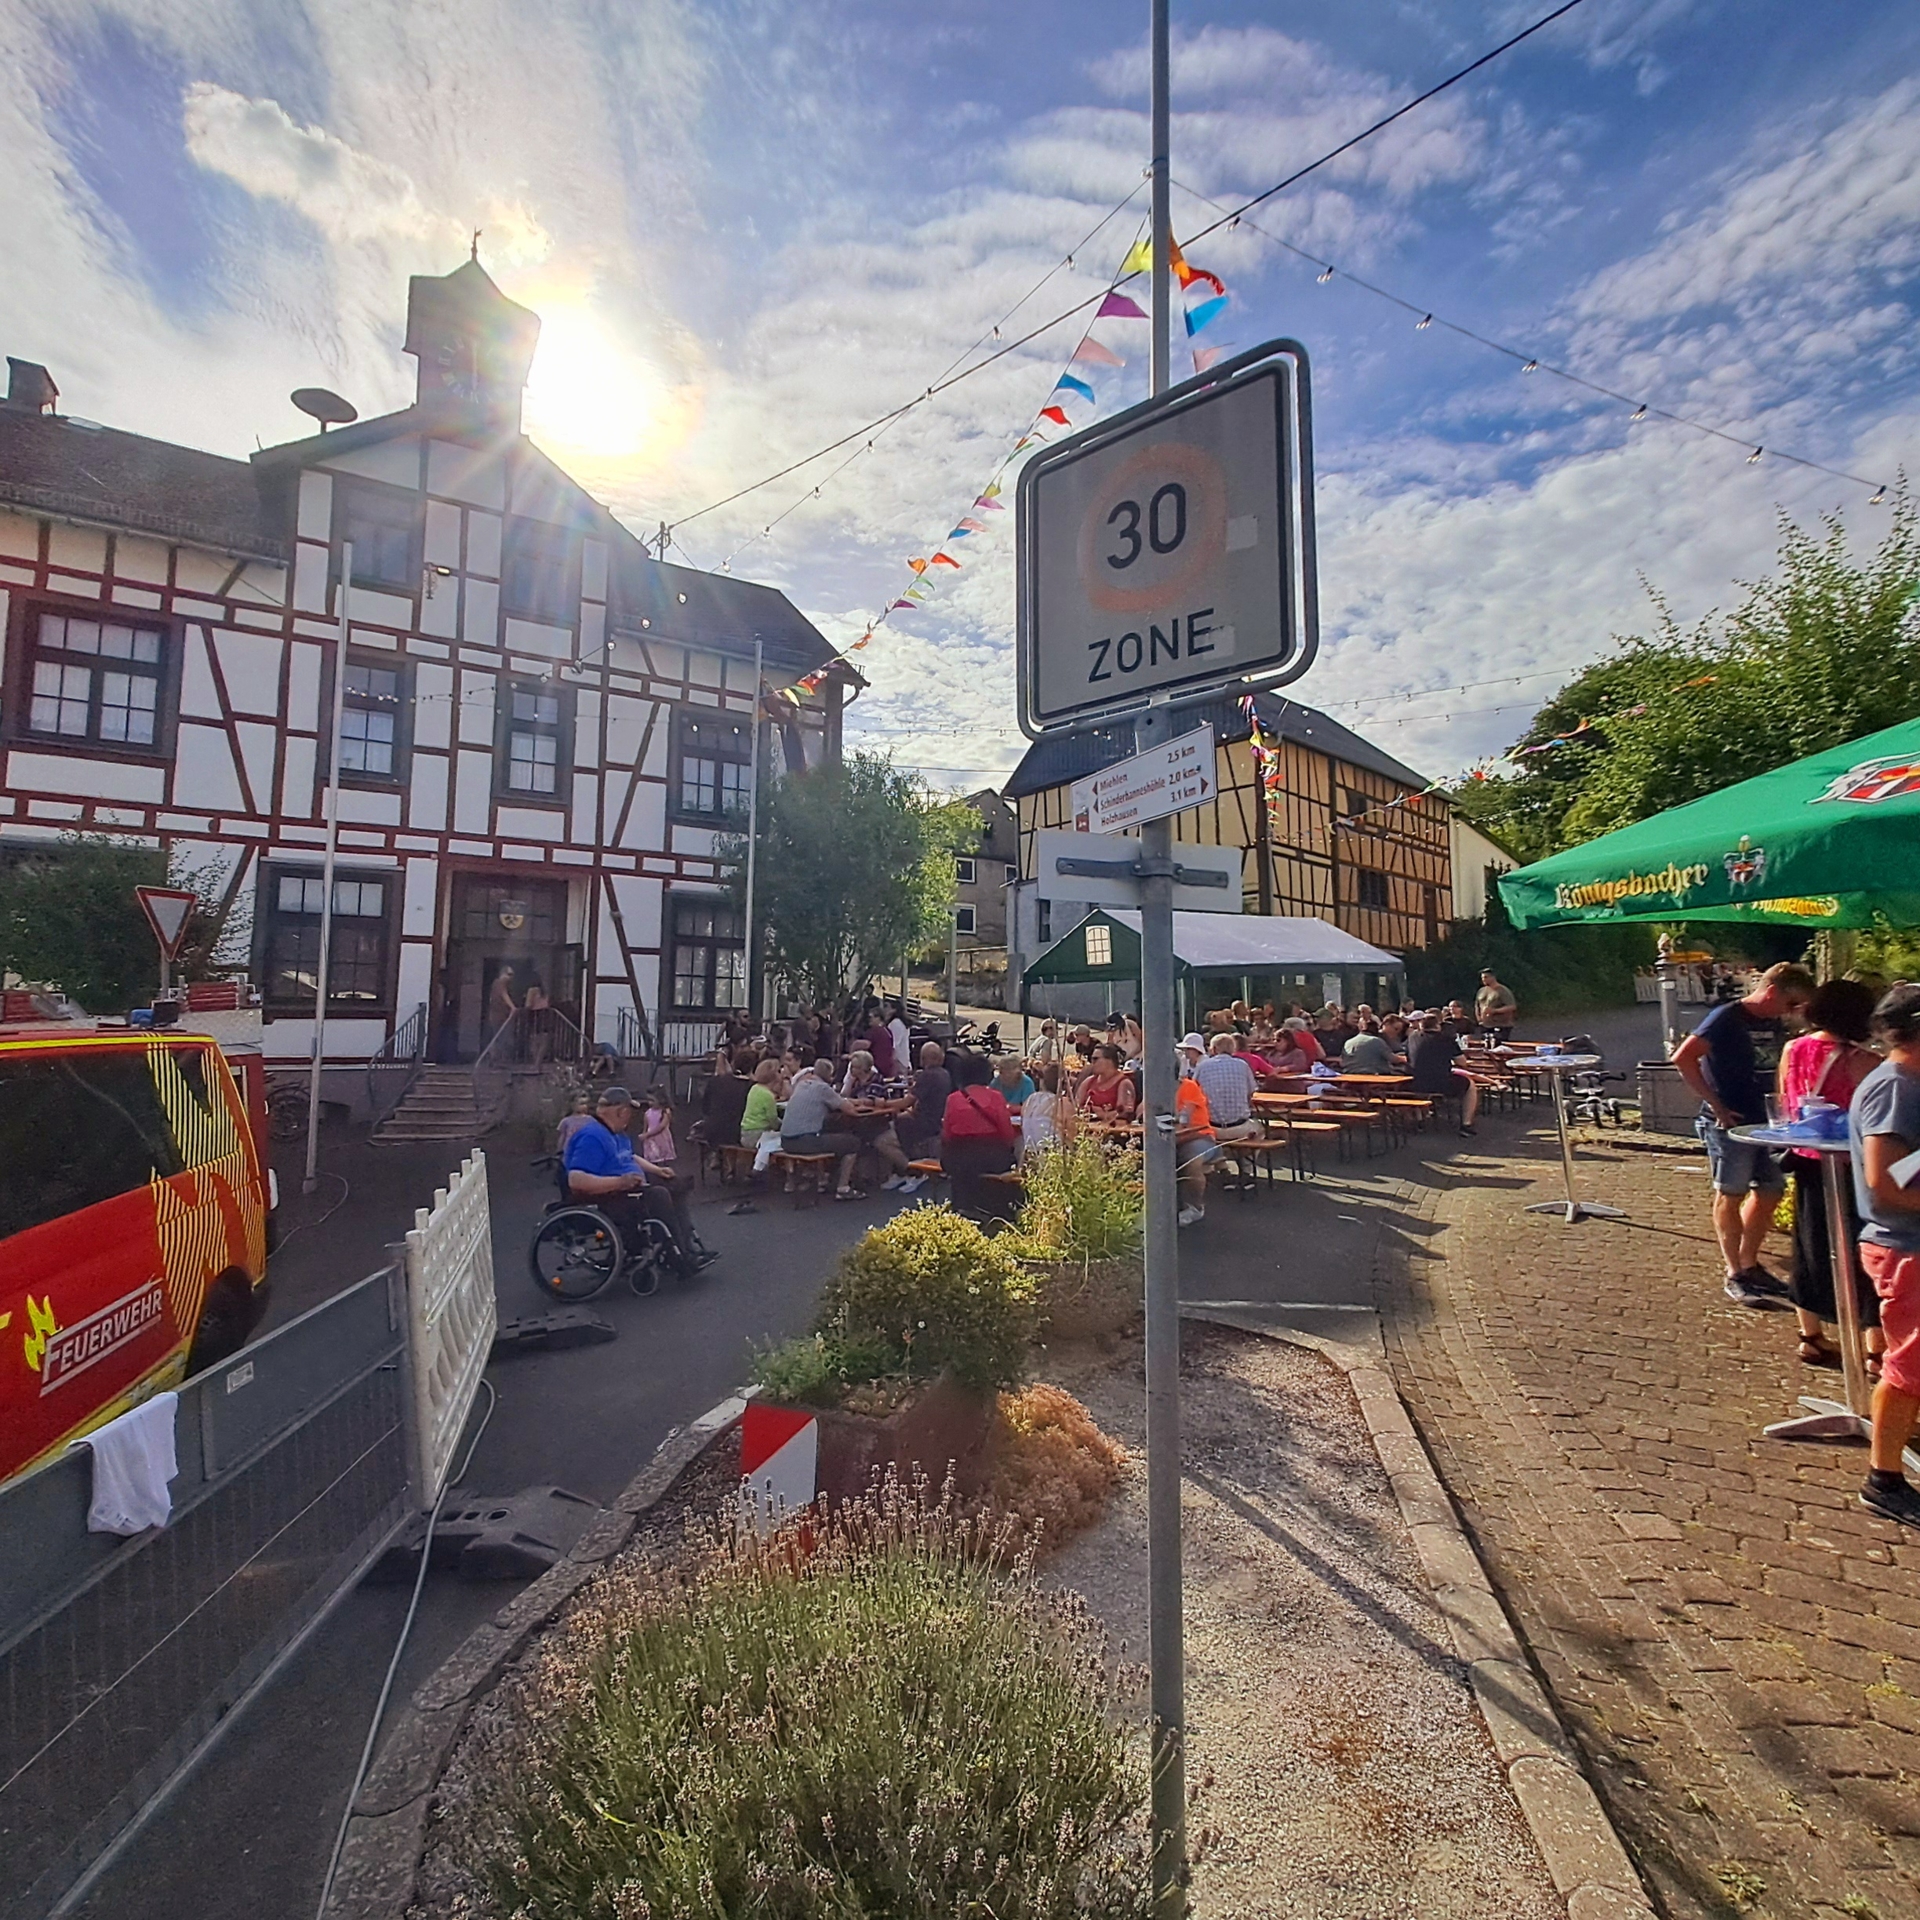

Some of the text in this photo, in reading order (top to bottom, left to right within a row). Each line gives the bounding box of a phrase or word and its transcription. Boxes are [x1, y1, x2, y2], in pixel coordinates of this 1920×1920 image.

[1107, 483, 1186, 569] 30
[1088, 608, 1215, 683] ZONE
[1100, 773, 1128, 791] Miehlen
[1181, 746, 1196, 758] km
[1183, 767, 1197, 779] km
[1101, 807, 1138, 827] Holzhausen
[1183, 786, 1197, 798] km
[1554, 862, 1709, 909] Königsbacher
[42, 1288, 163, 1385] FEUERWEHR
